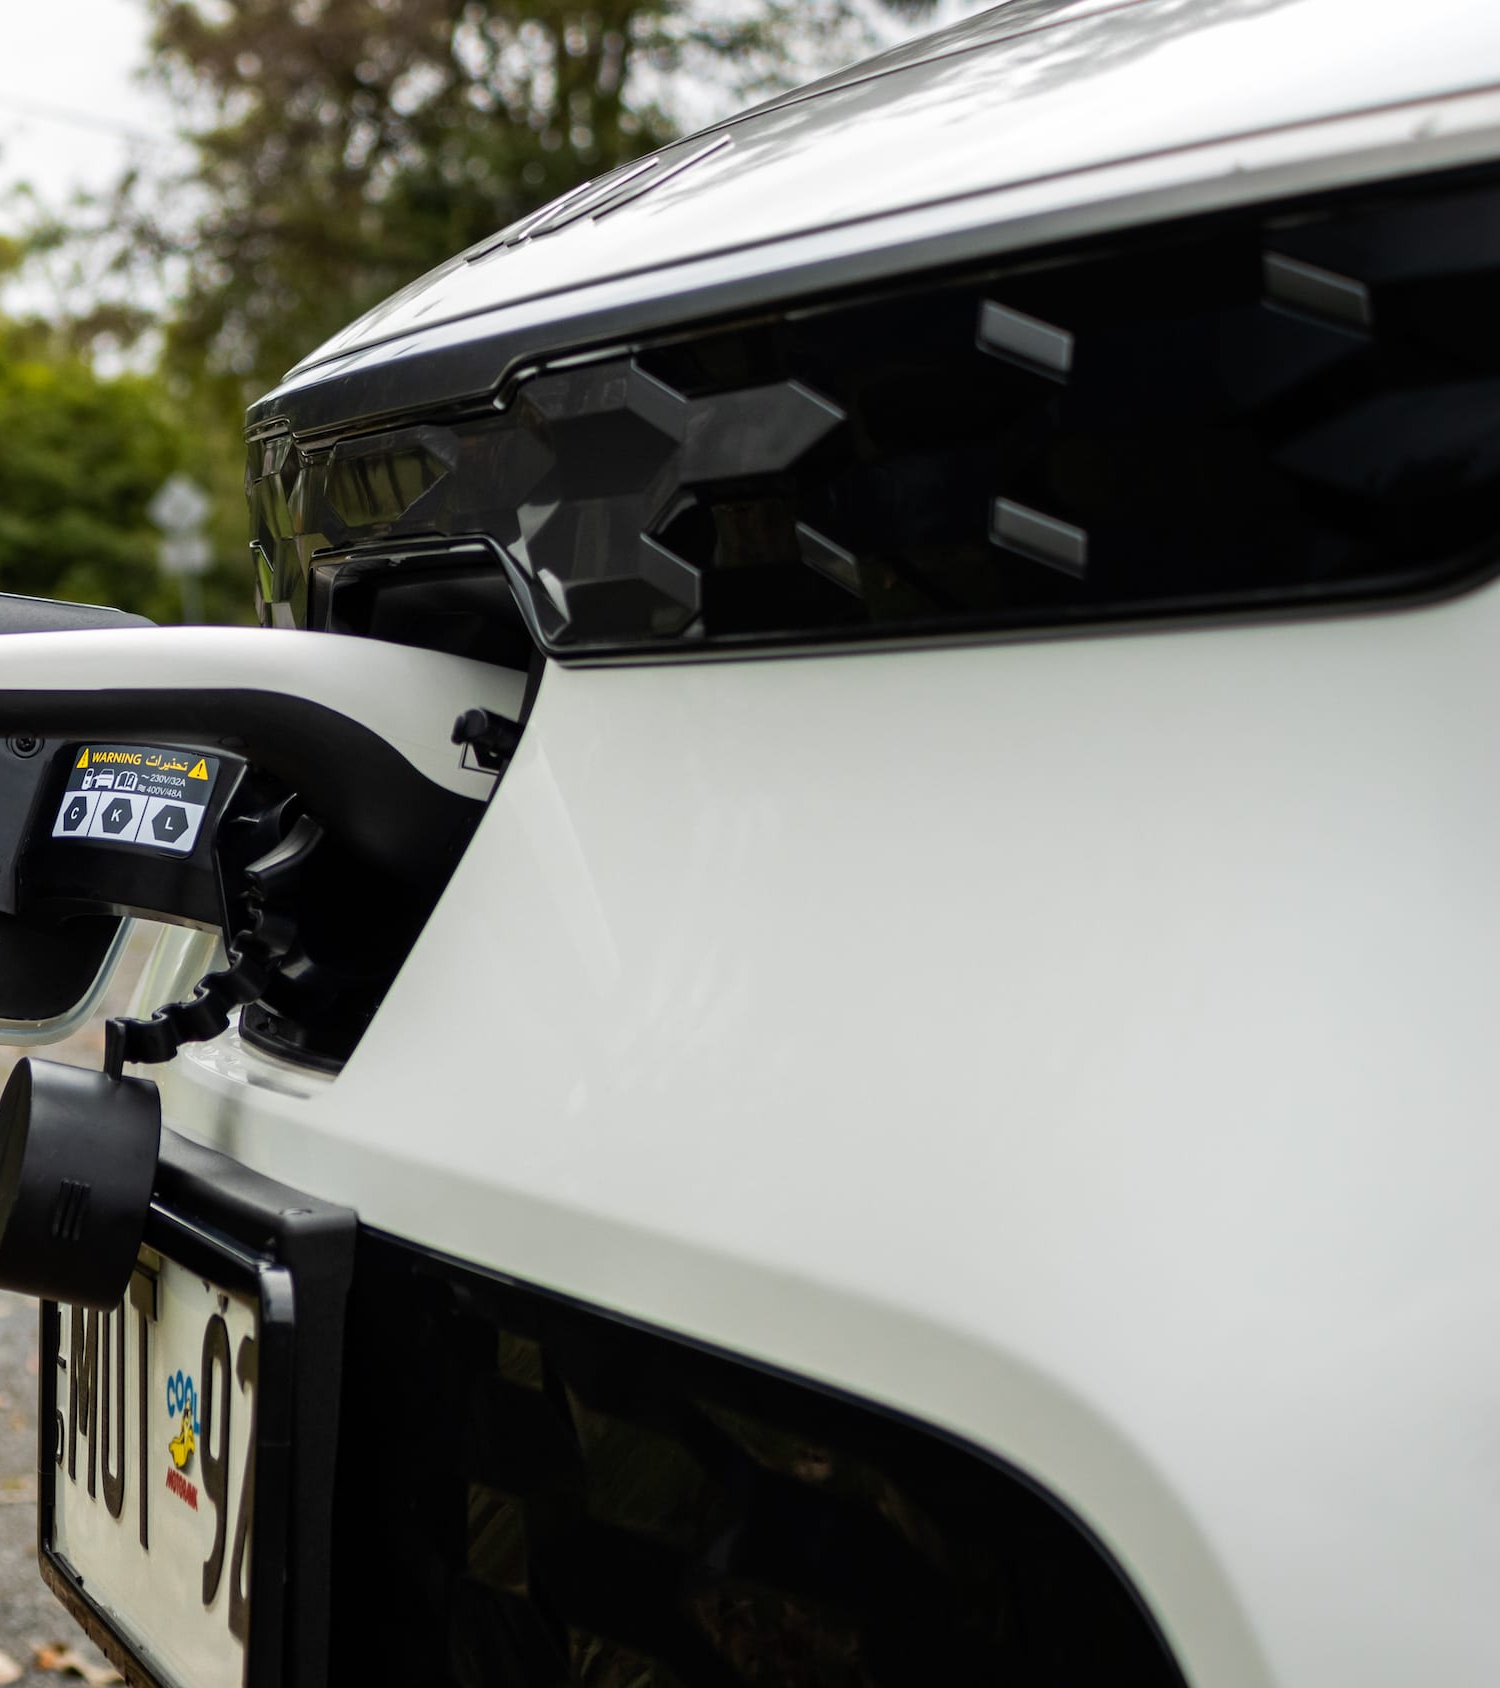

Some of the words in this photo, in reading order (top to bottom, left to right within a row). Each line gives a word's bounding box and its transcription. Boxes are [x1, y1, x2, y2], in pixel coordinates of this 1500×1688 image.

[91, 751, 143, 766] WARNING
[145, 753, 189, 772] تحذيرات
[70, 806, 80, 820] C
[110, 808, 123, 823] K
[164, 816, 175, 831] L
[166, 1369, 201, 1435] COOL
